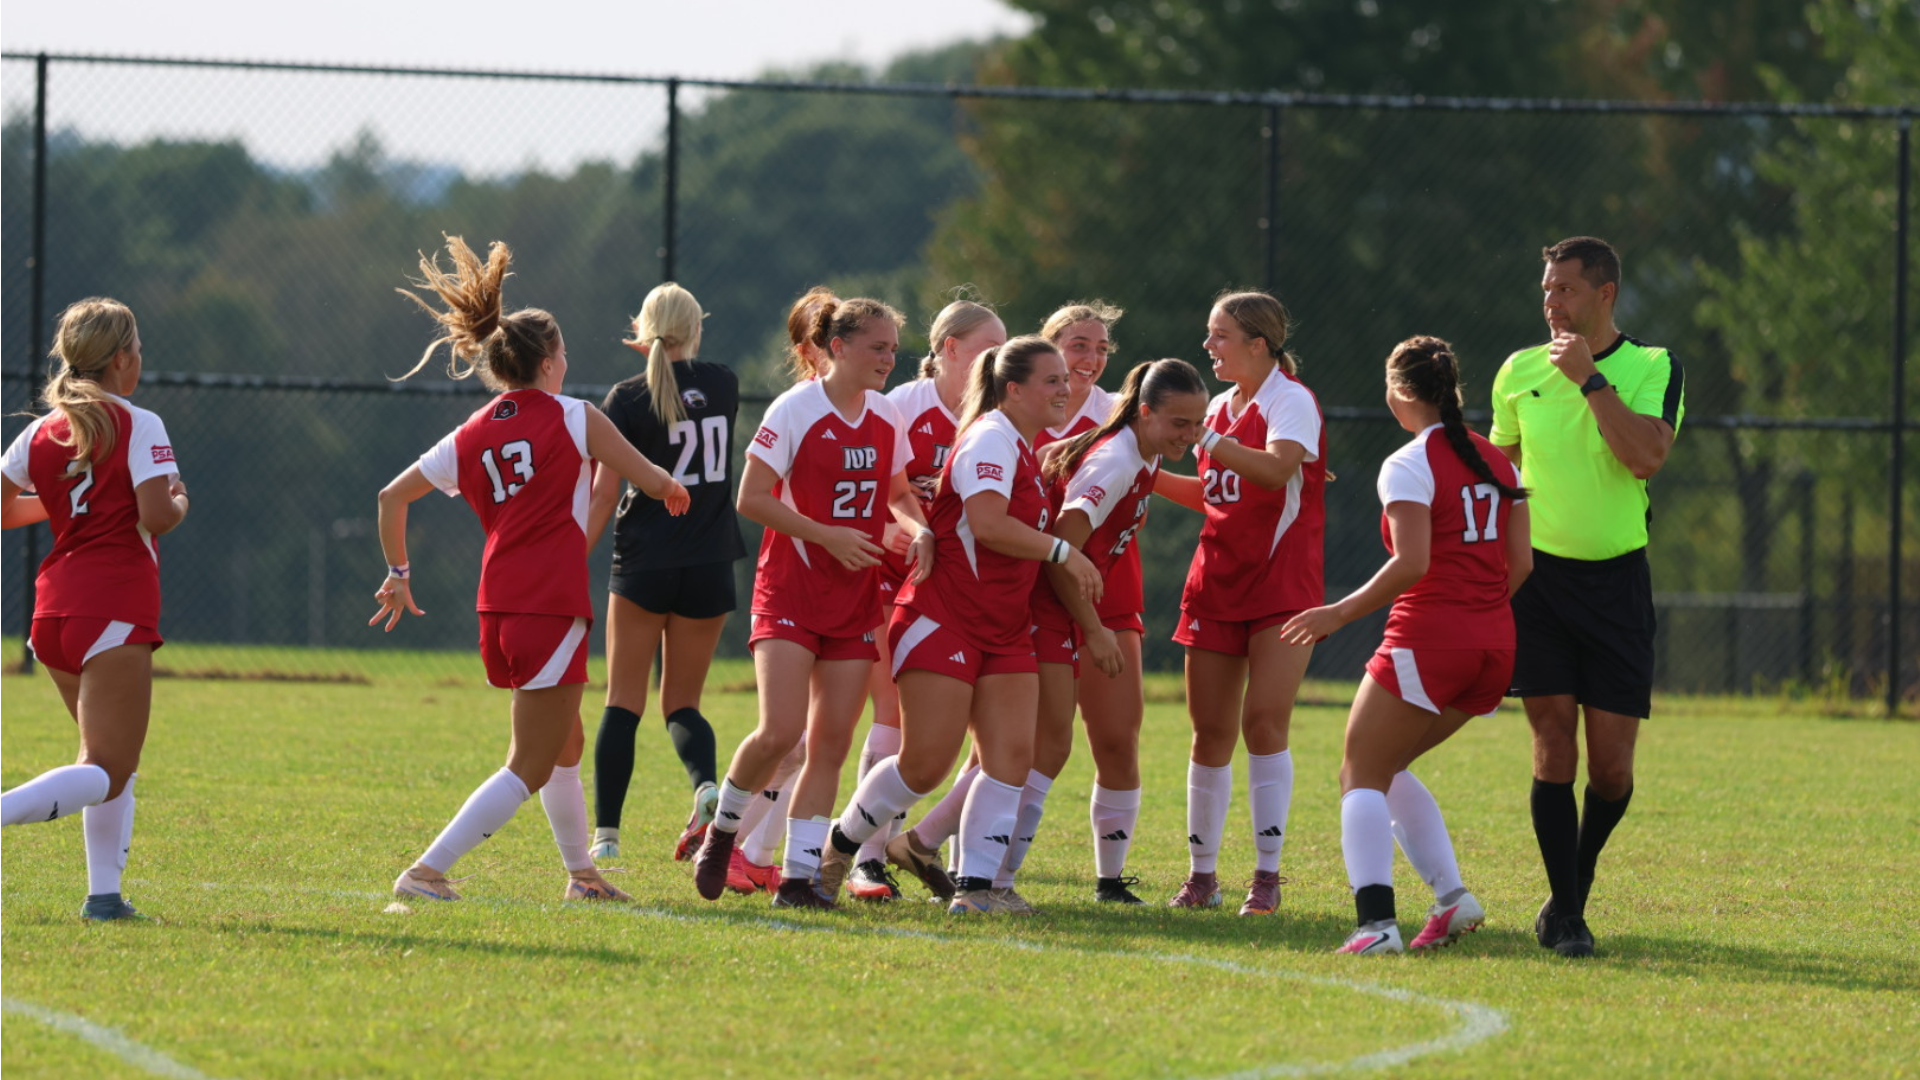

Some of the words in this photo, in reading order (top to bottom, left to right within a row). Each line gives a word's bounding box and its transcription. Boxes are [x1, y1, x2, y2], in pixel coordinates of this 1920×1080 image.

[151, 449, 174, 460] PSA
[668, 415, 728, 486] 20
[757, 429, 777, 447] SAC
[481, 439, 536, 504] 13
[842, 446, 877, 470] IUP
[976, 465, 1004, 478] PSAC
[66, 459, 94, 518] 2
[832, 480, 878, 518] 27
[1203, 468, 1241, 505] 20
[1460, 483, 1501, 543] 17
